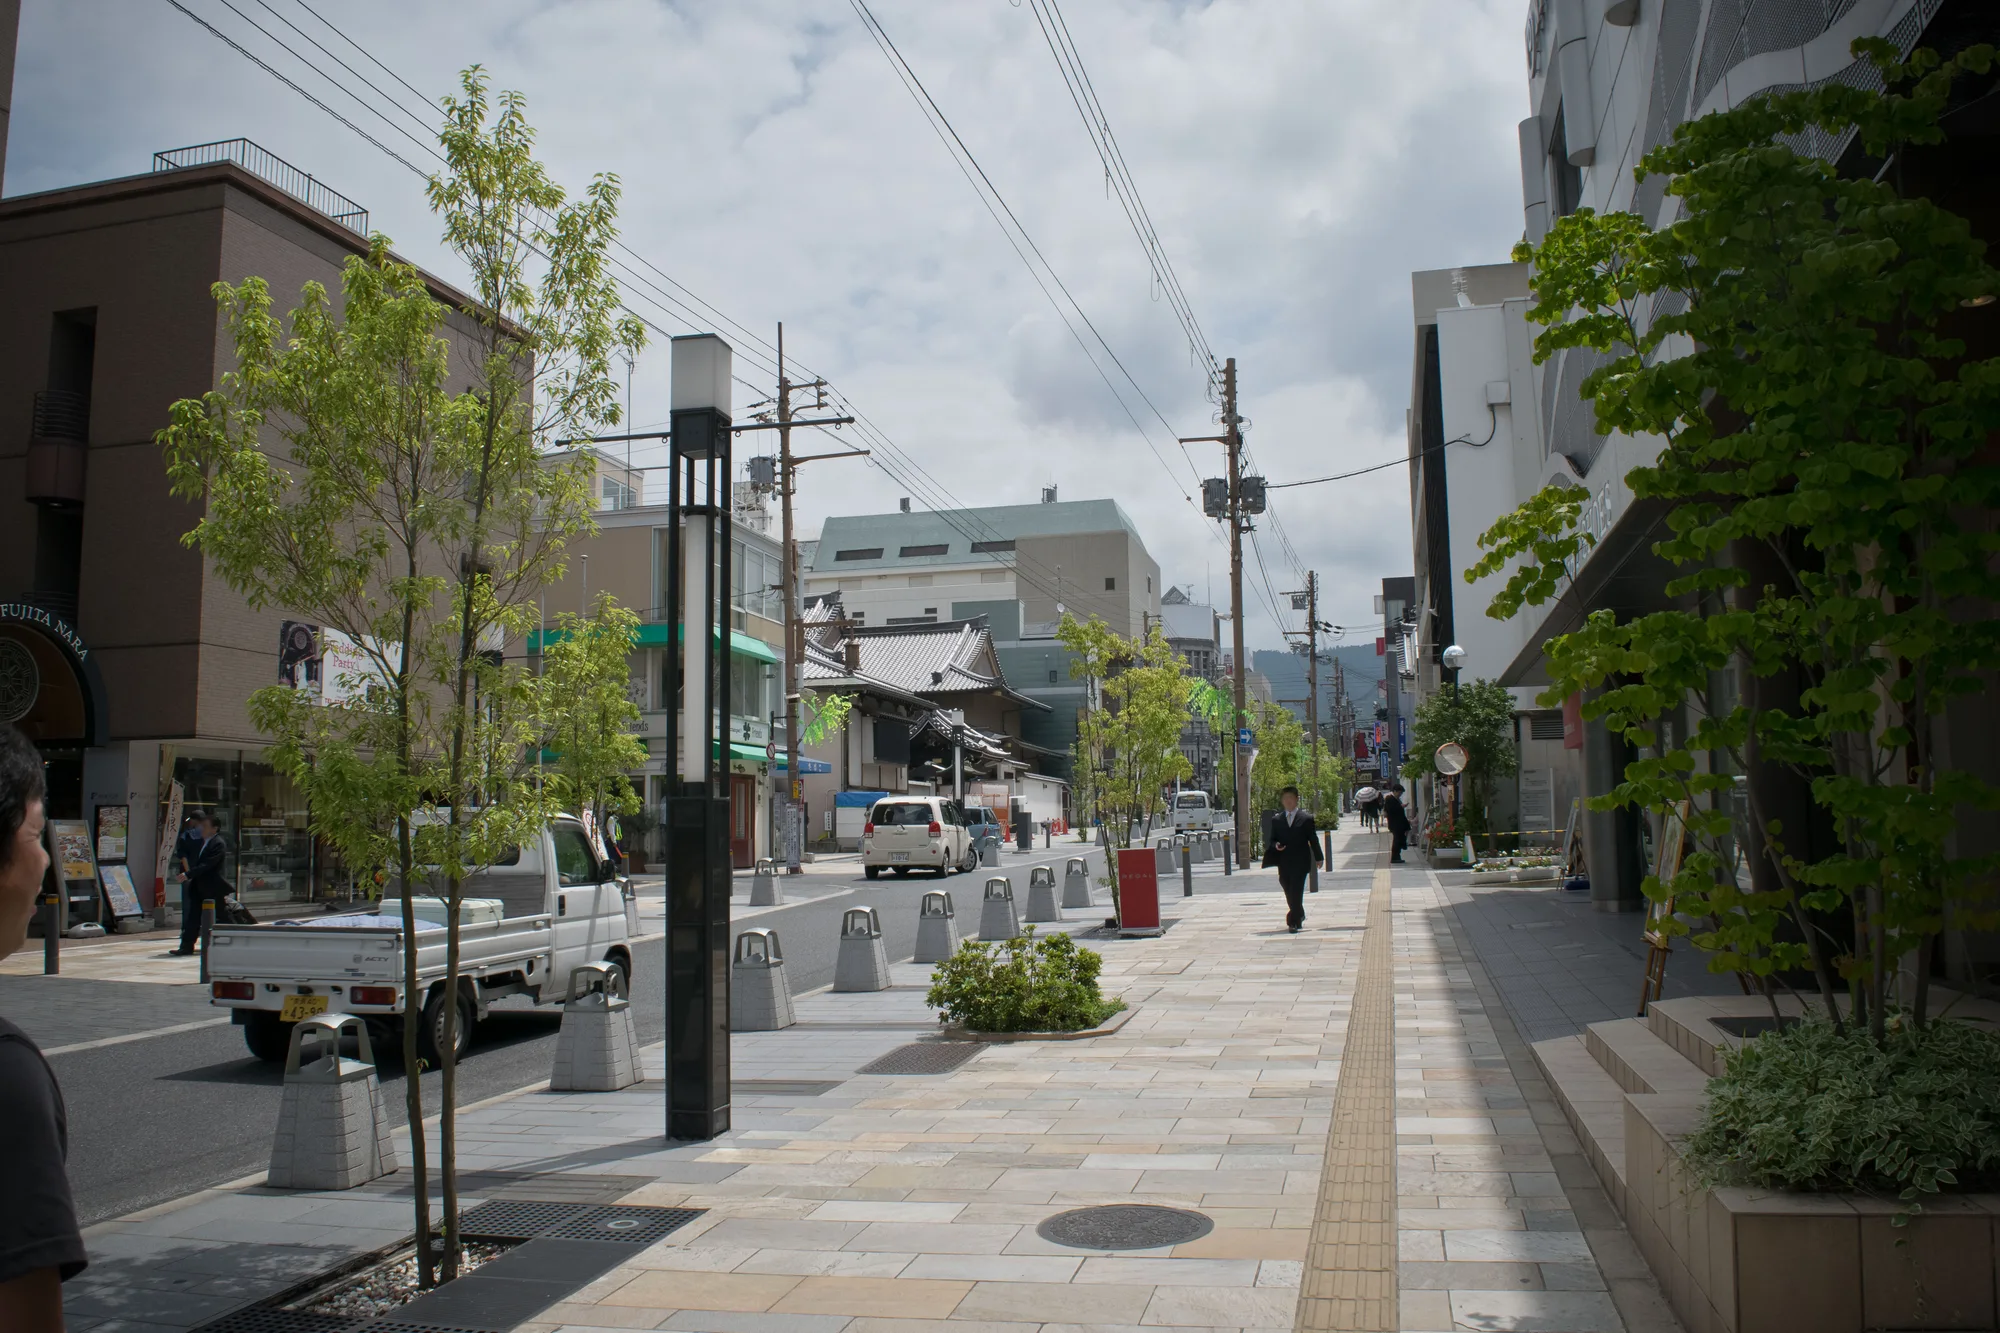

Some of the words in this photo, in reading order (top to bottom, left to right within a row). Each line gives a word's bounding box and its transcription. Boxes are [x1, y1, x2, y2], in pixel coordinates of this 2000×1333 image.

[0, 603, 50, 627] FUJITA
[54, 620, 88, 661] NARA
[332, 655, 356, 672] Party
[621, 720, 649, 732] Fiends
